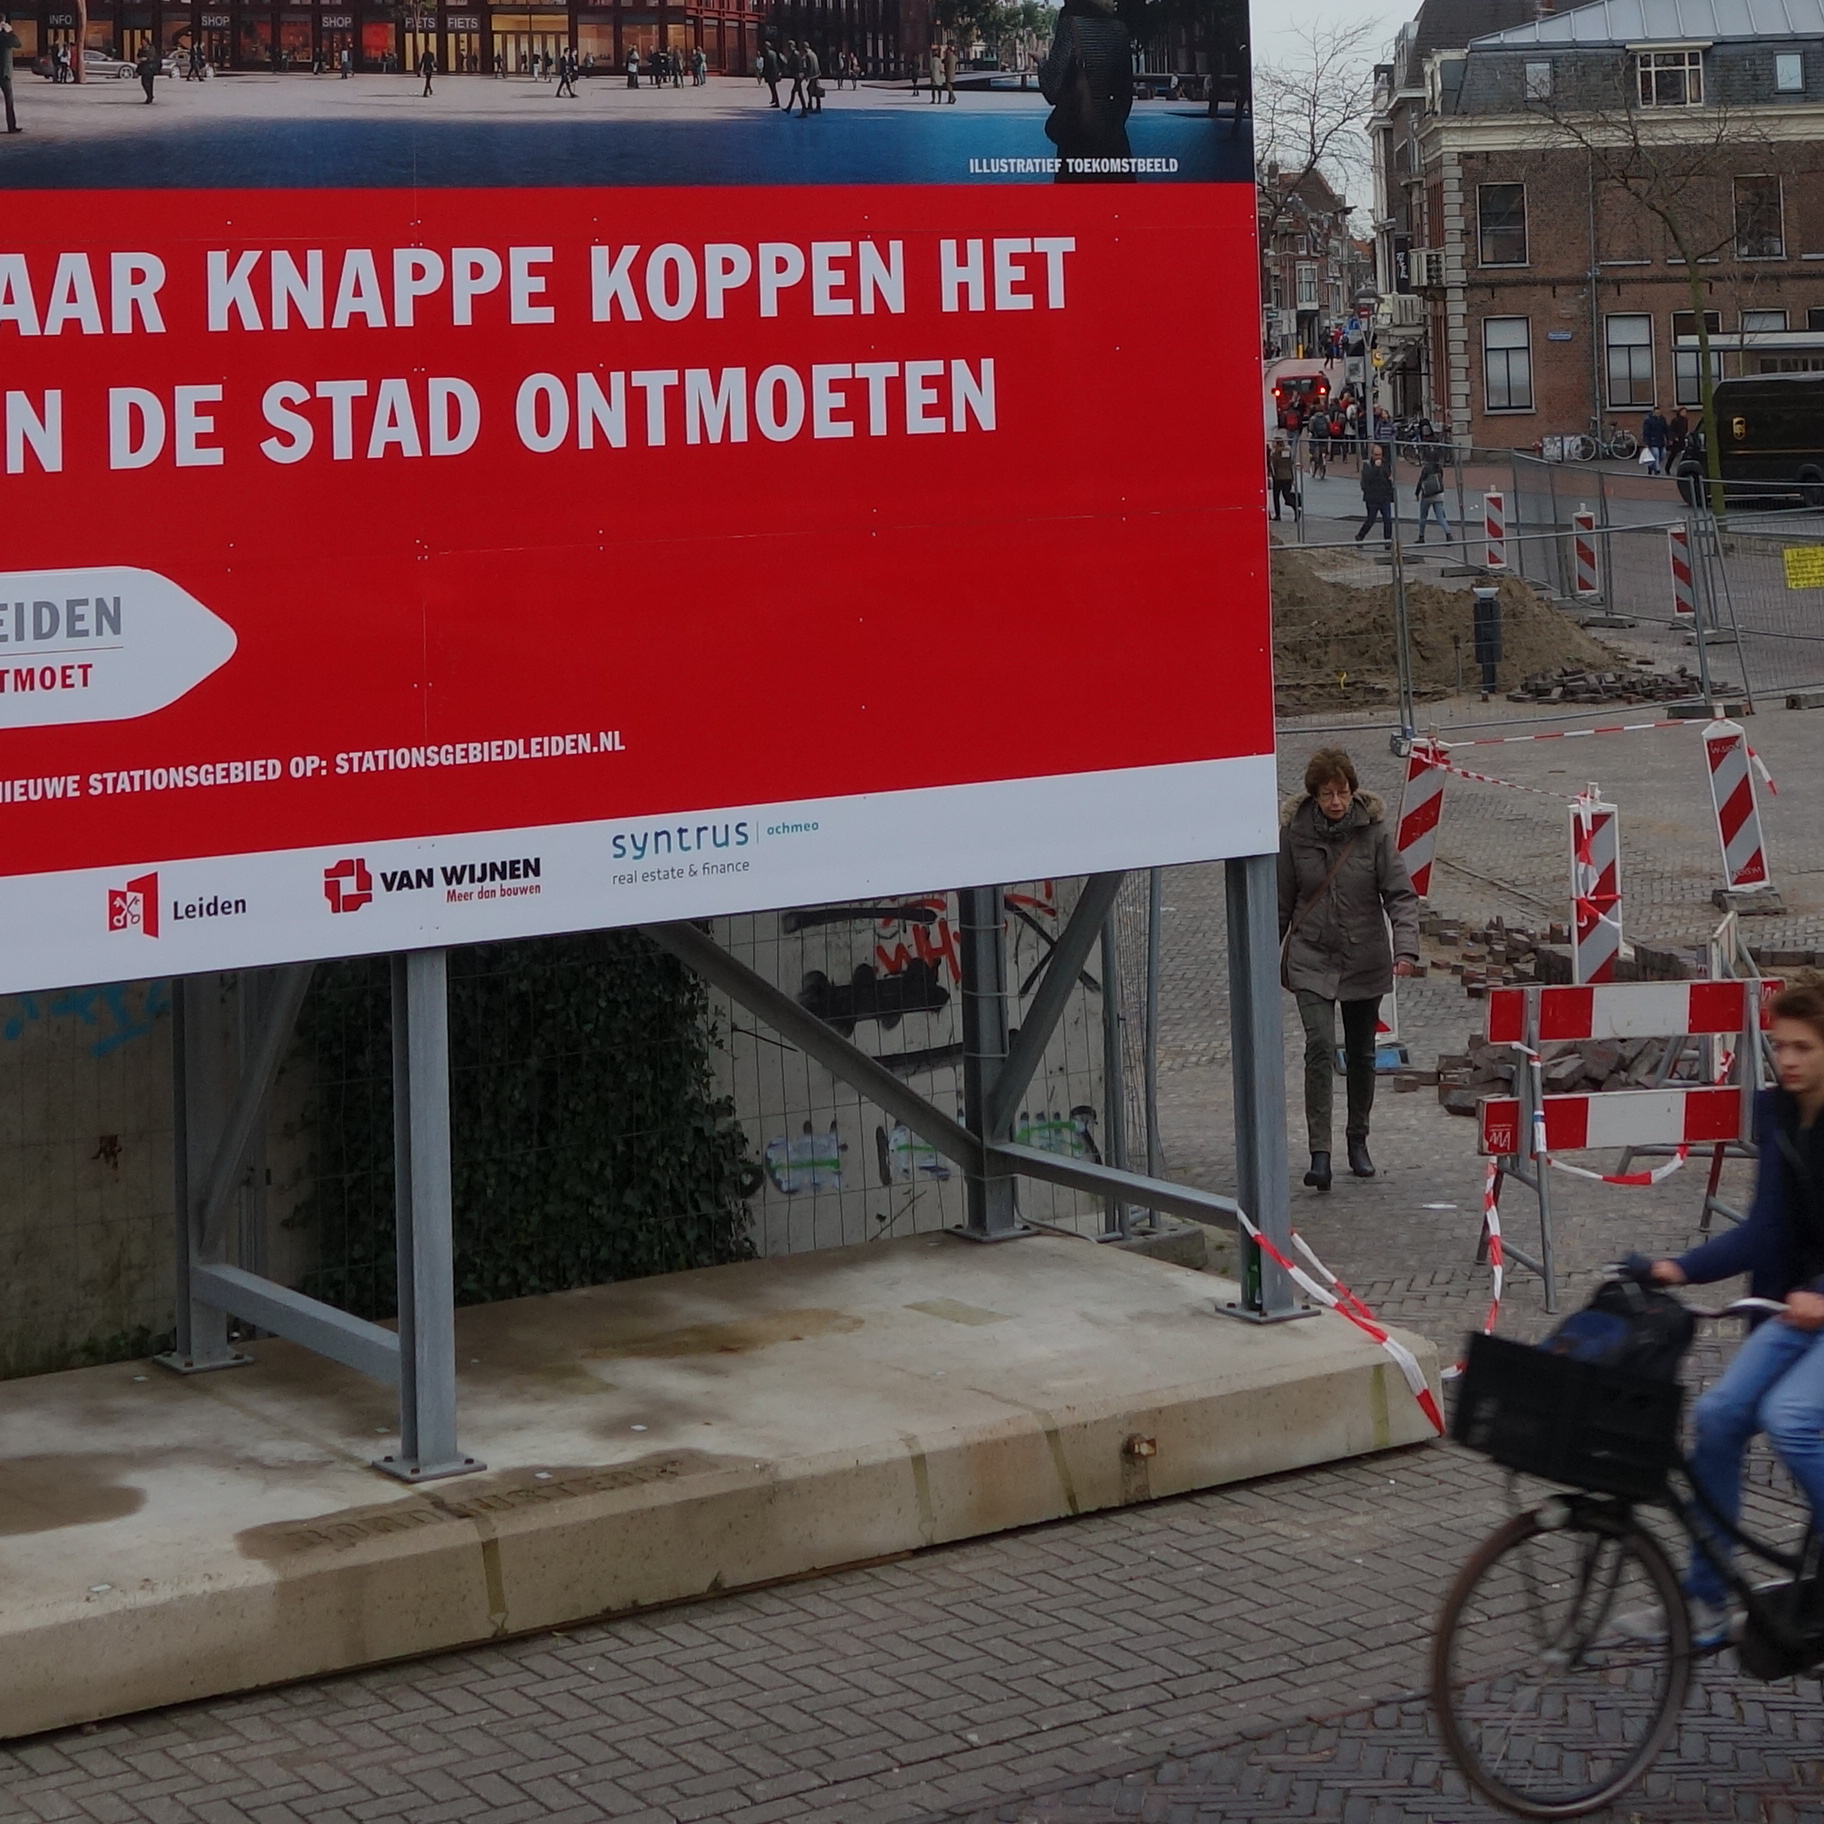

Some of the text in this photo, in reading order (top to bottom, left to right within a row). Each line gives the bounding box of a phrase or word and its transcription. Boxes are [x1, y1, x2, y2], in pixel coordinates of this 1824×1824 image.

[969, 158, 1179, 174] ILLUSTRATIEF TOEKOMSTBEELD
[207, 245, 556, 334] KNAPPE
[592, 240, 906, 323] KOPPEN
[939, 236, 1076, 313] HET
[108, 384, 226, 471] DE
[260, 377, 483, 464] STAD
[515, 357, 998, 454] ONTMOETEN
[88, 759, 282, 796] STATIONSGEBIED
[289, 753, 328, 781] OP:
[335, 730, 625, 776] STATIONSGEBIEDLEIDEN.NL
[612, 821, 819, 860] syntrus achmea
[380, 857, 542, 893] VAN WIJNEN
[612, 859, 750, 885] real estate & finance
[172, 892, 248, 920] Leiden
[446, 882, 541, 903] Meer dan bouwen
